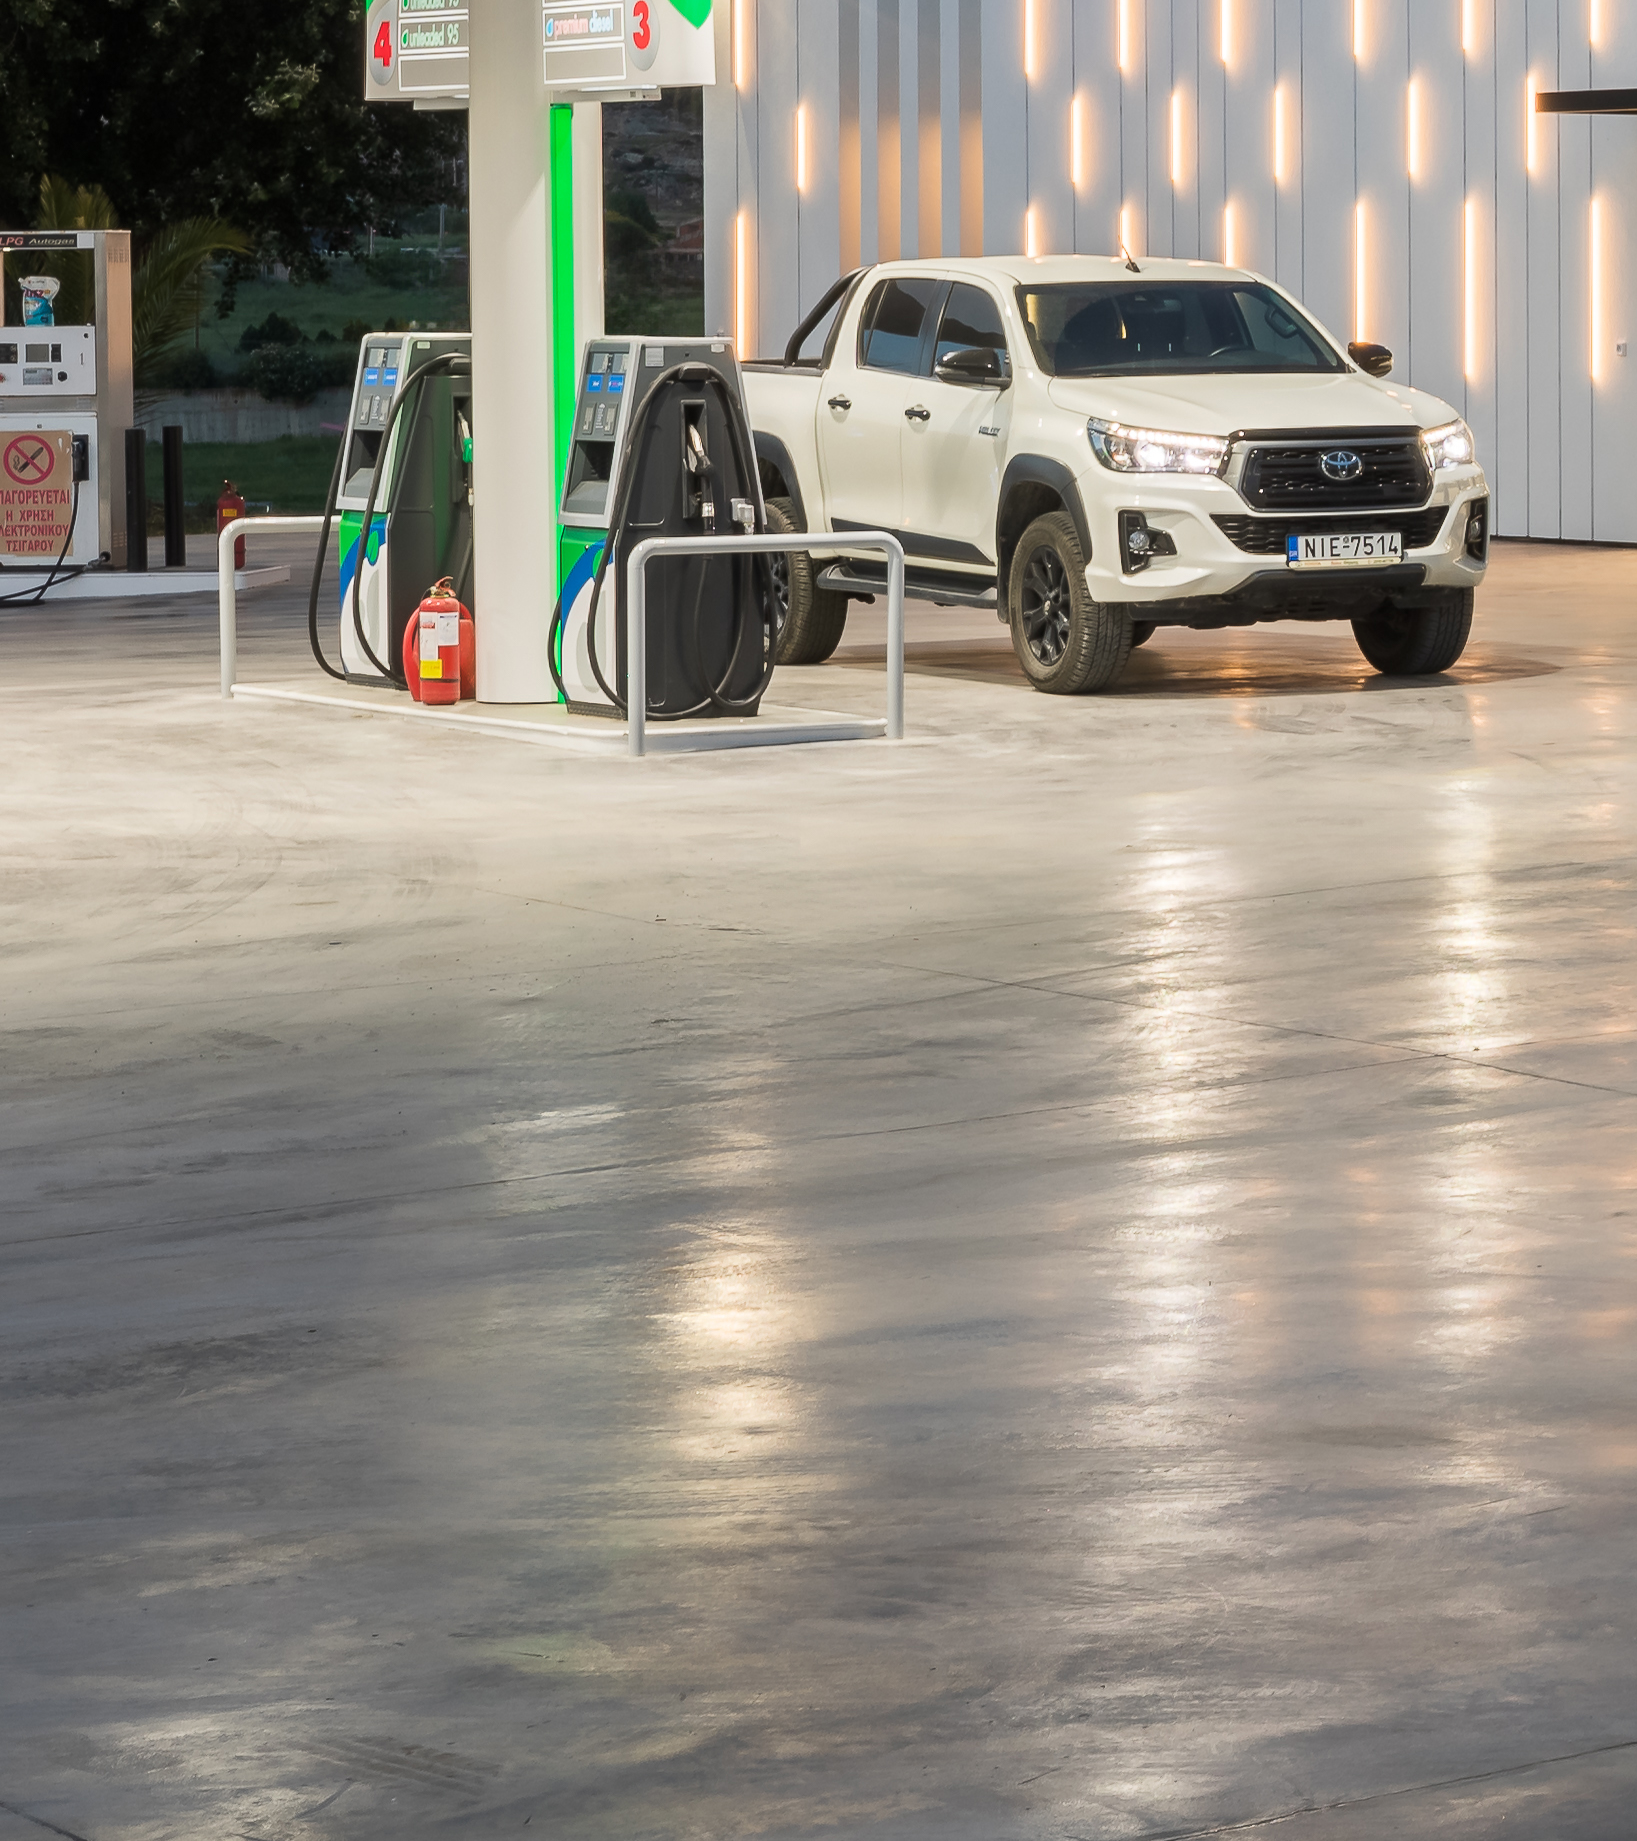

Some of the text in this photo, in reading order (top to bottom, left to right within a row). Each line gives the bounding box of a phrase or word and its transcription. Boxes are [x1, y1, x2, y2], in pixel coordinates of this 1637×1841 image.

[409, 23, 459, 47] unleaded 95
[554, 9, 613, 40] premium diesel
[633, 0, 650, 50] 3
[373, 21, 391, 67] 4
[29, 238, 74, 246] Autogas
[6, 509, 54, 522] Η ΧΡΗΣΗ
[6, 539, 54, 552] ΤΣΙΓΑΡΟΥ
